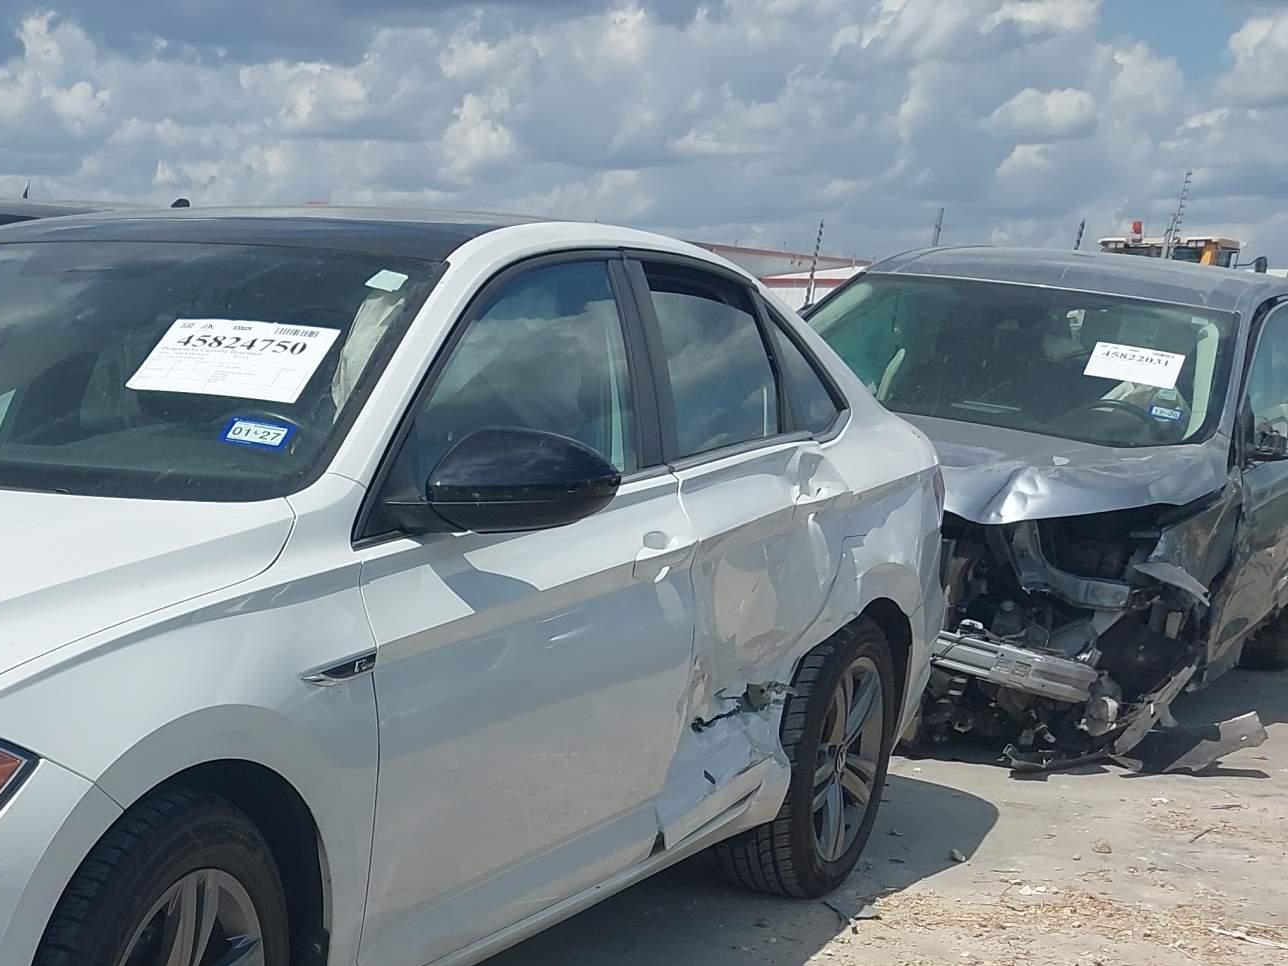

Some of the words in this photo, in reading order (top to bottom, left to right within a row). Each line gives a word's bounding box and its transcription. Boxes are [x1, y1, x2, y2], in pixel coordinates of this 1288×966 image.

[176, 334, 308, 356] 45824750
[231, 426, 252, 438] 01
[258, 430, 283, 442] 27
